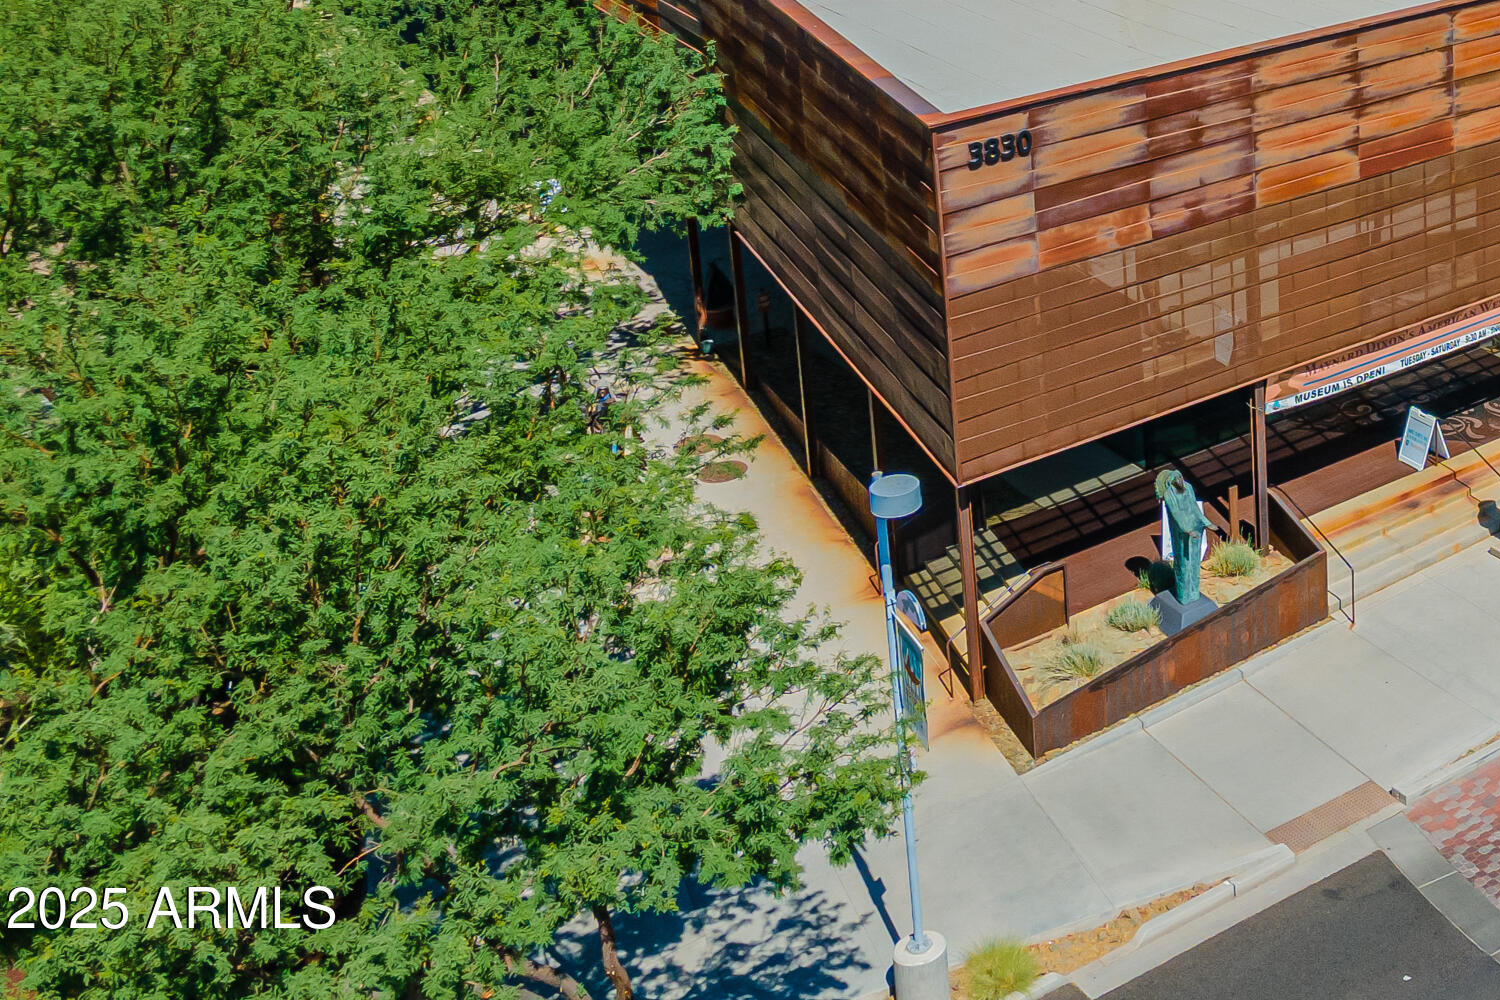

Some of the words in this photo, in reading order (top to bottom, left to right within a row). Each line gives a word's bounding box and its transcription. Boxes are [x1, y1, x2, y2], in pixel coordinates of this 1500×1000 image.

[968, 128, 1032, 171] 3830
[1420, 307, 1477, 334] AMERICAN
[1295, 383, 1340, 404] MUSEUM
[1343, 378, 1353, 389] IS
[1400, 350, 1427, 367] TUESDAY
[1431, 338, 1460, 356] SATURDAY
